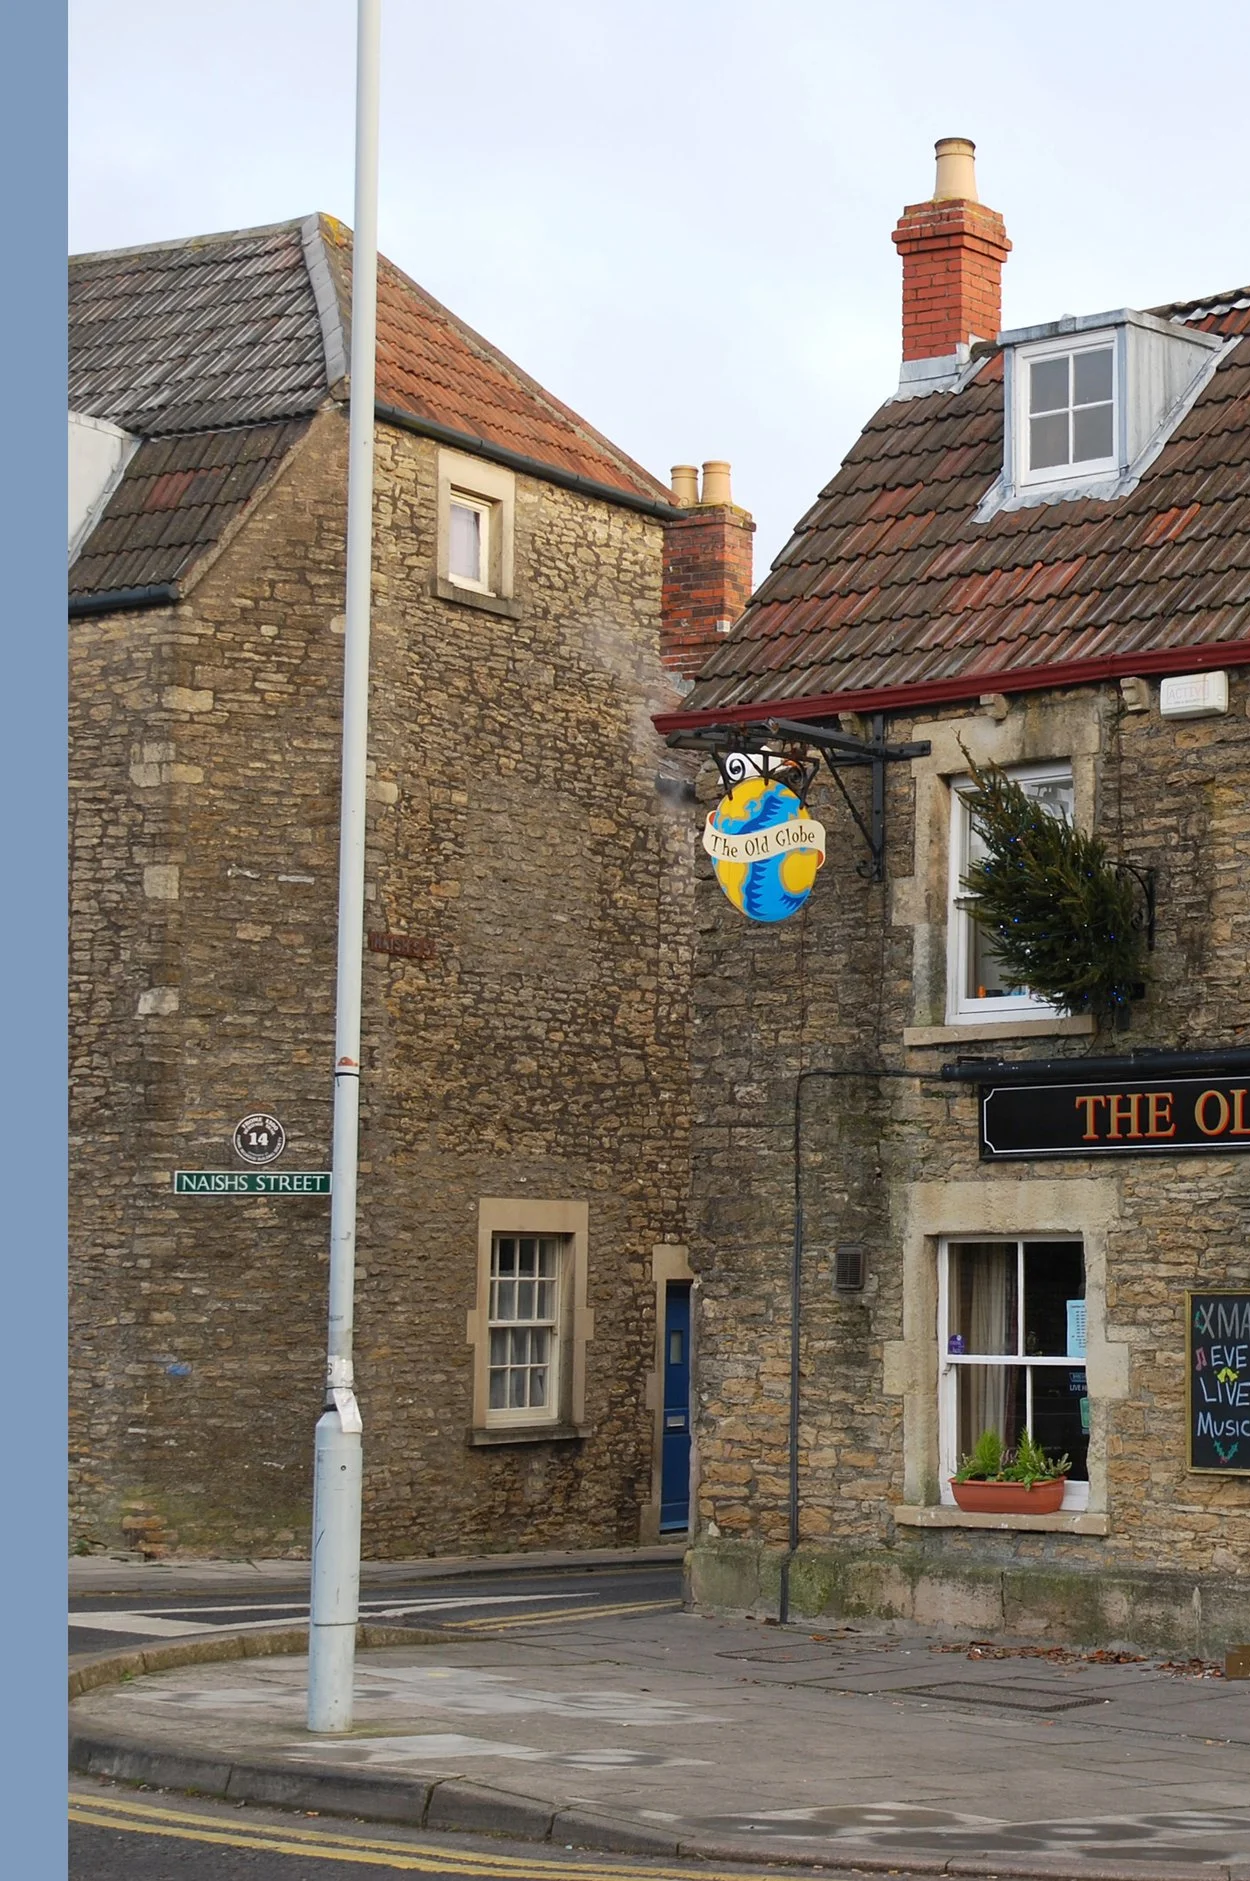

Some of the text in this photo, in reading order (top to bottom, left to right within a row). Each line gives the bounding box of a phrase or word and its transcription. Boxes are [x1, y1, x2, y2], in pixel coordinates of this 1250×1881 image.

[711, 826, 815, 858] The Old Globe
[1075, 1093, 1175, 1140] THE
[249, 1131, 269, 1146] 14
[182, 1175, 325, 1191] NAISHS STREET
[1211, 1345, 1249, 1368] EVE
